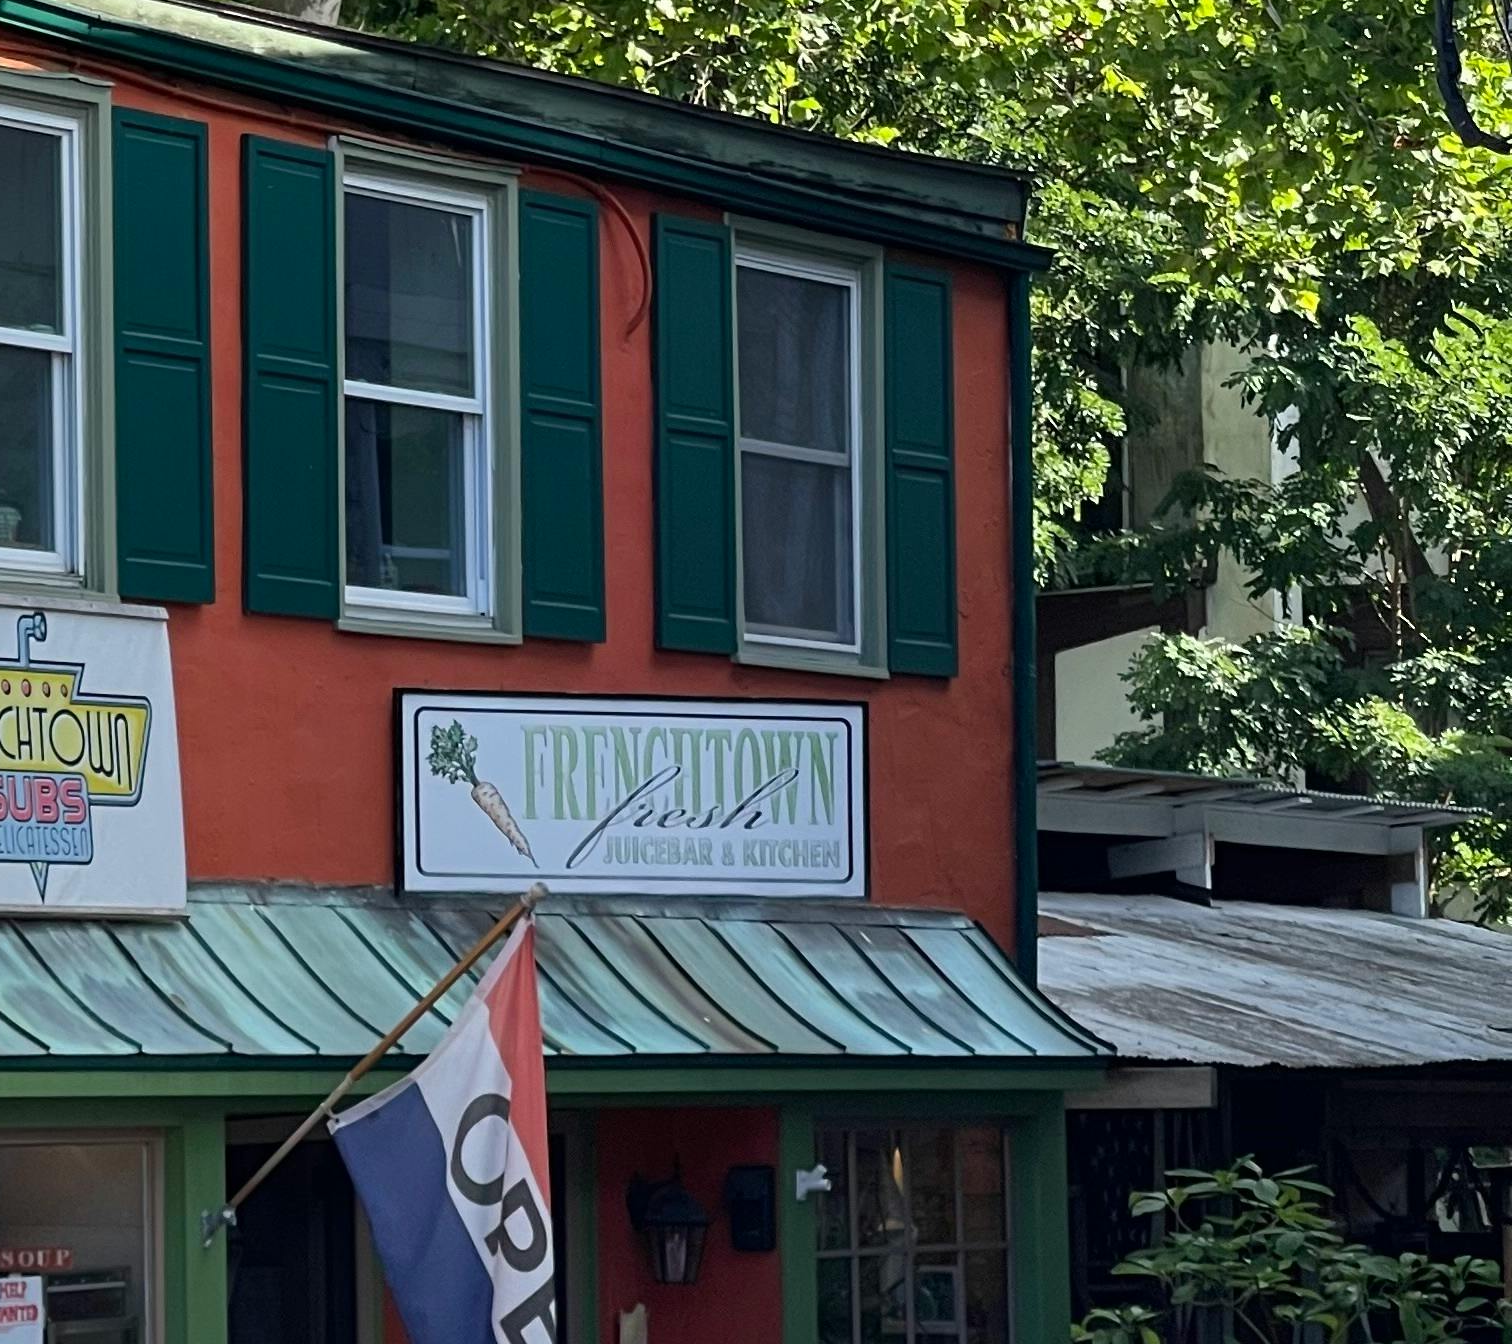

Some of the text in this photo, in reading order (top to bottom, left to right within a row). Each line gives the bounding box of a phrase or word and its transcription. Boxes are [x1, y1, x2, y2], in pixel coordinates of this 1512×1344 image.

[520, 724, 839, 827] FRENCHTOWN
[566, 764, 799, 870] fresh
[602, 835, 841, 869] JUICEBAR & KITCHEN
[0, 1249, 71, 1268] SOUP
[0, 1281, 27, 1301] HELP
